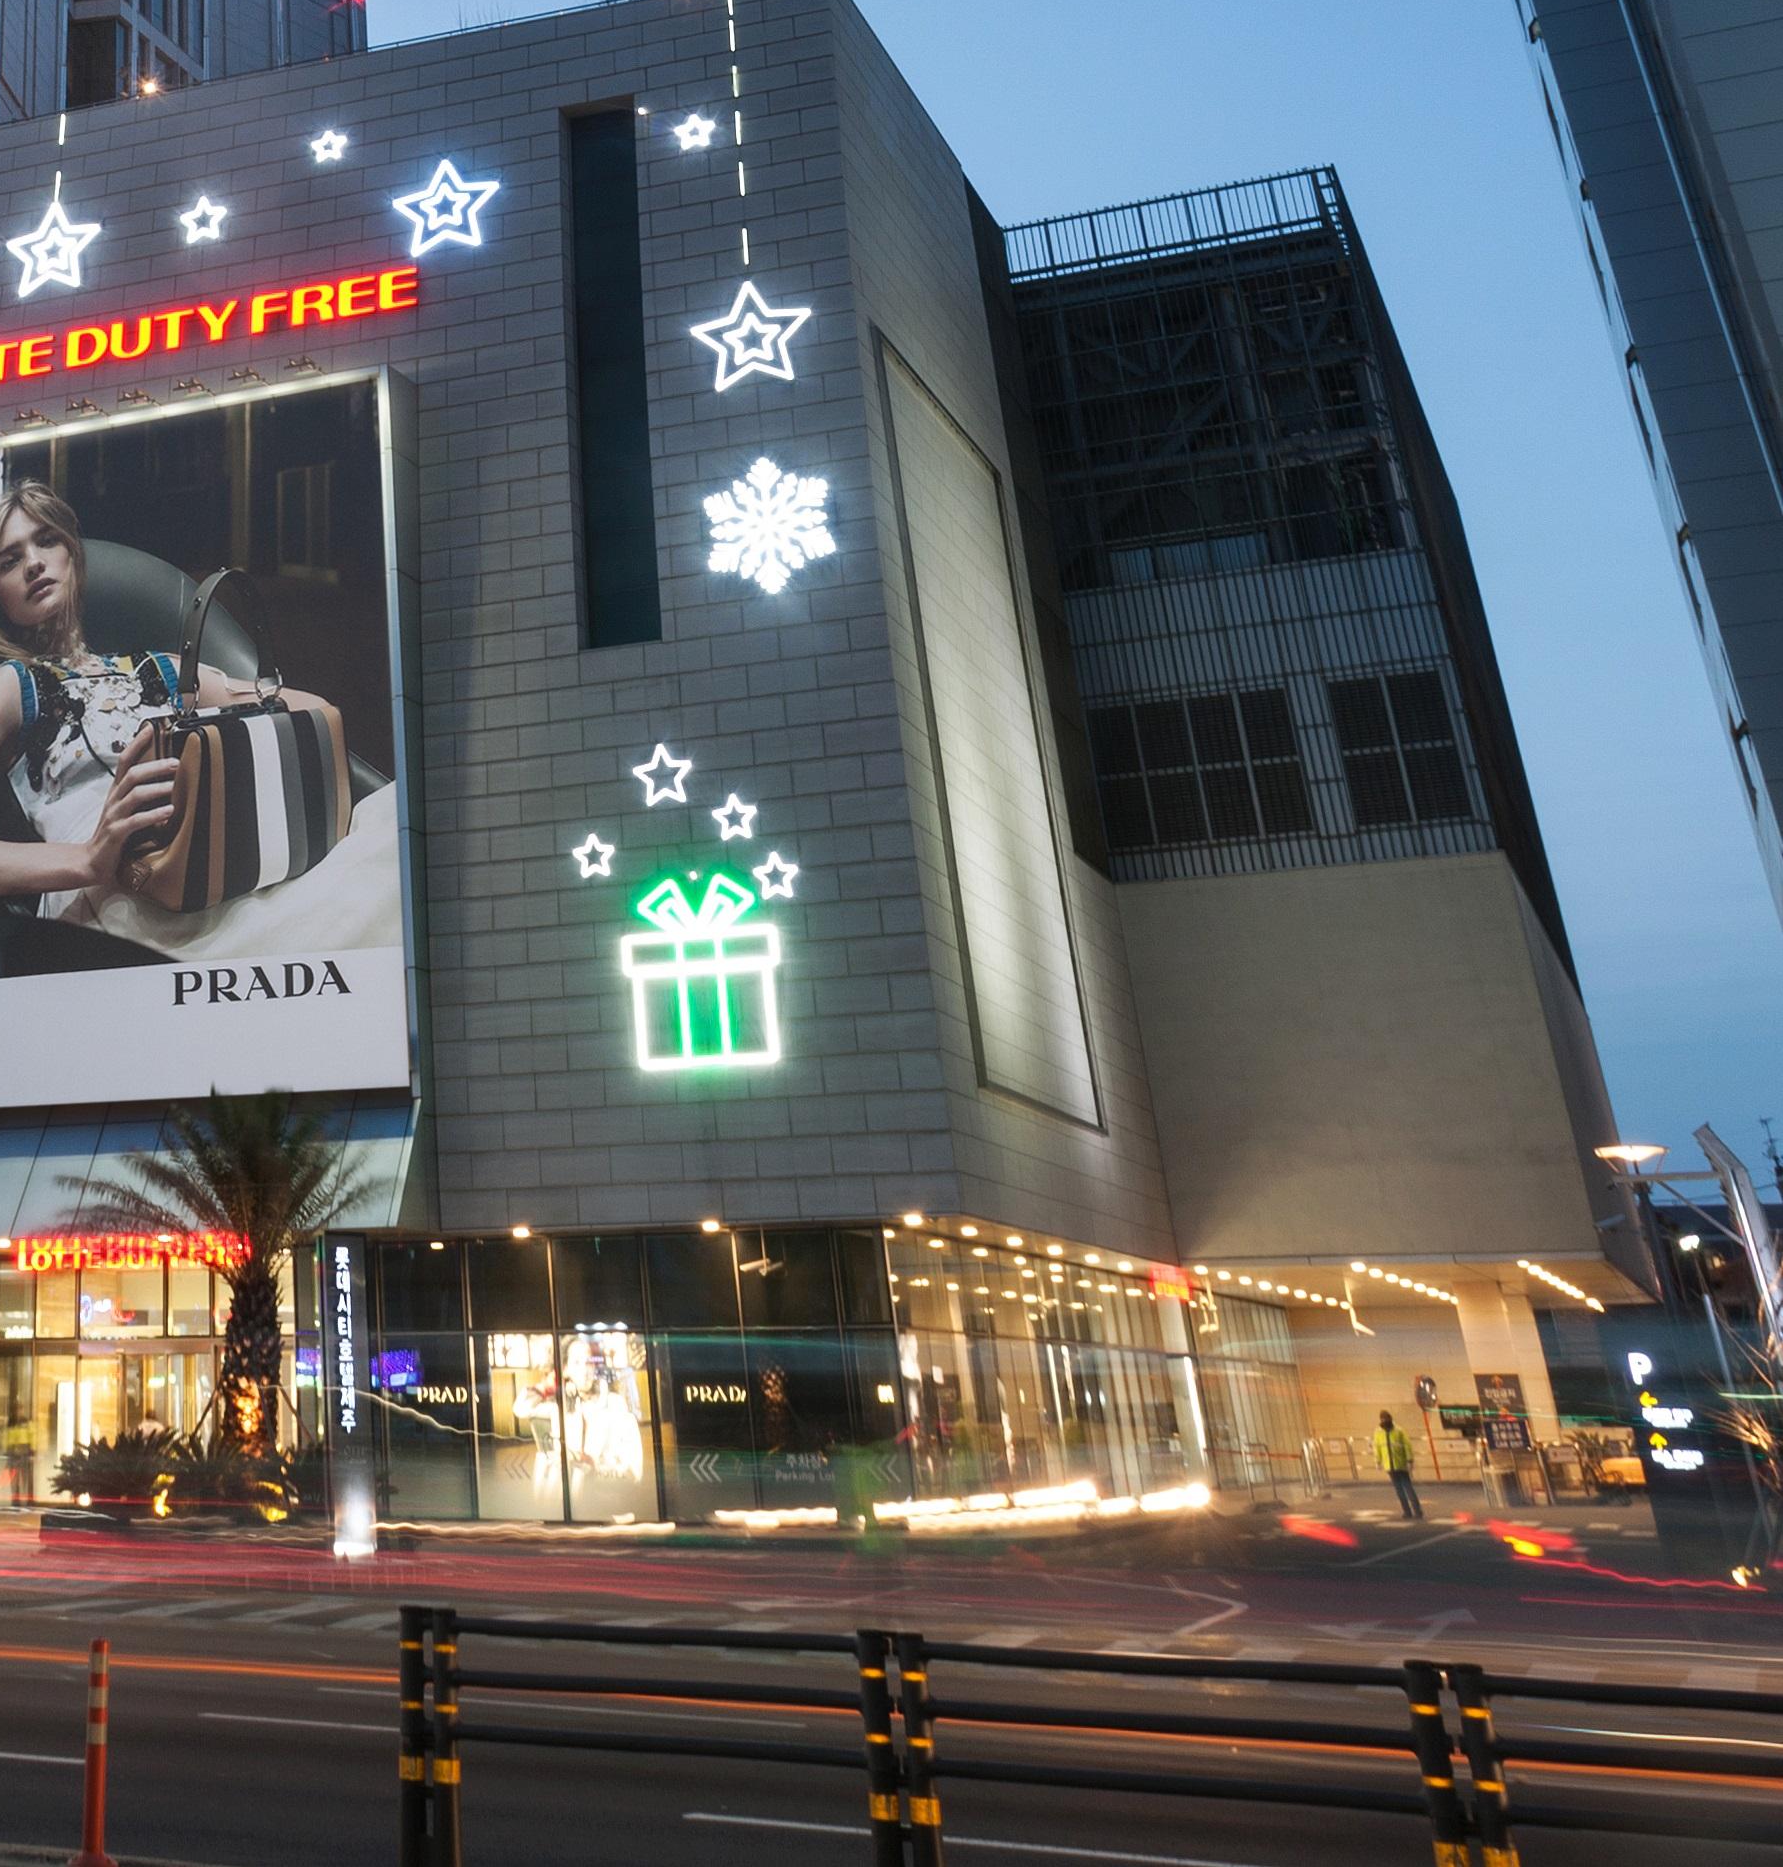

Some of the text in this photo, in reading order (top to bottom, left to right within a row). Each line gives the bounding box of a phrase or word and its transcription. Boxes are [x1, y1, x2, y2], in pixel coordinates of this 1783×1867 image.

[65, 299, 238, 369] DUTY
[250, 267, 419, 334] FREE
[173, 960, 351, 1006] PRADA
[1627, 1352, 1652, 1385] P
[417, 1385, 479, 1404] PRAD
